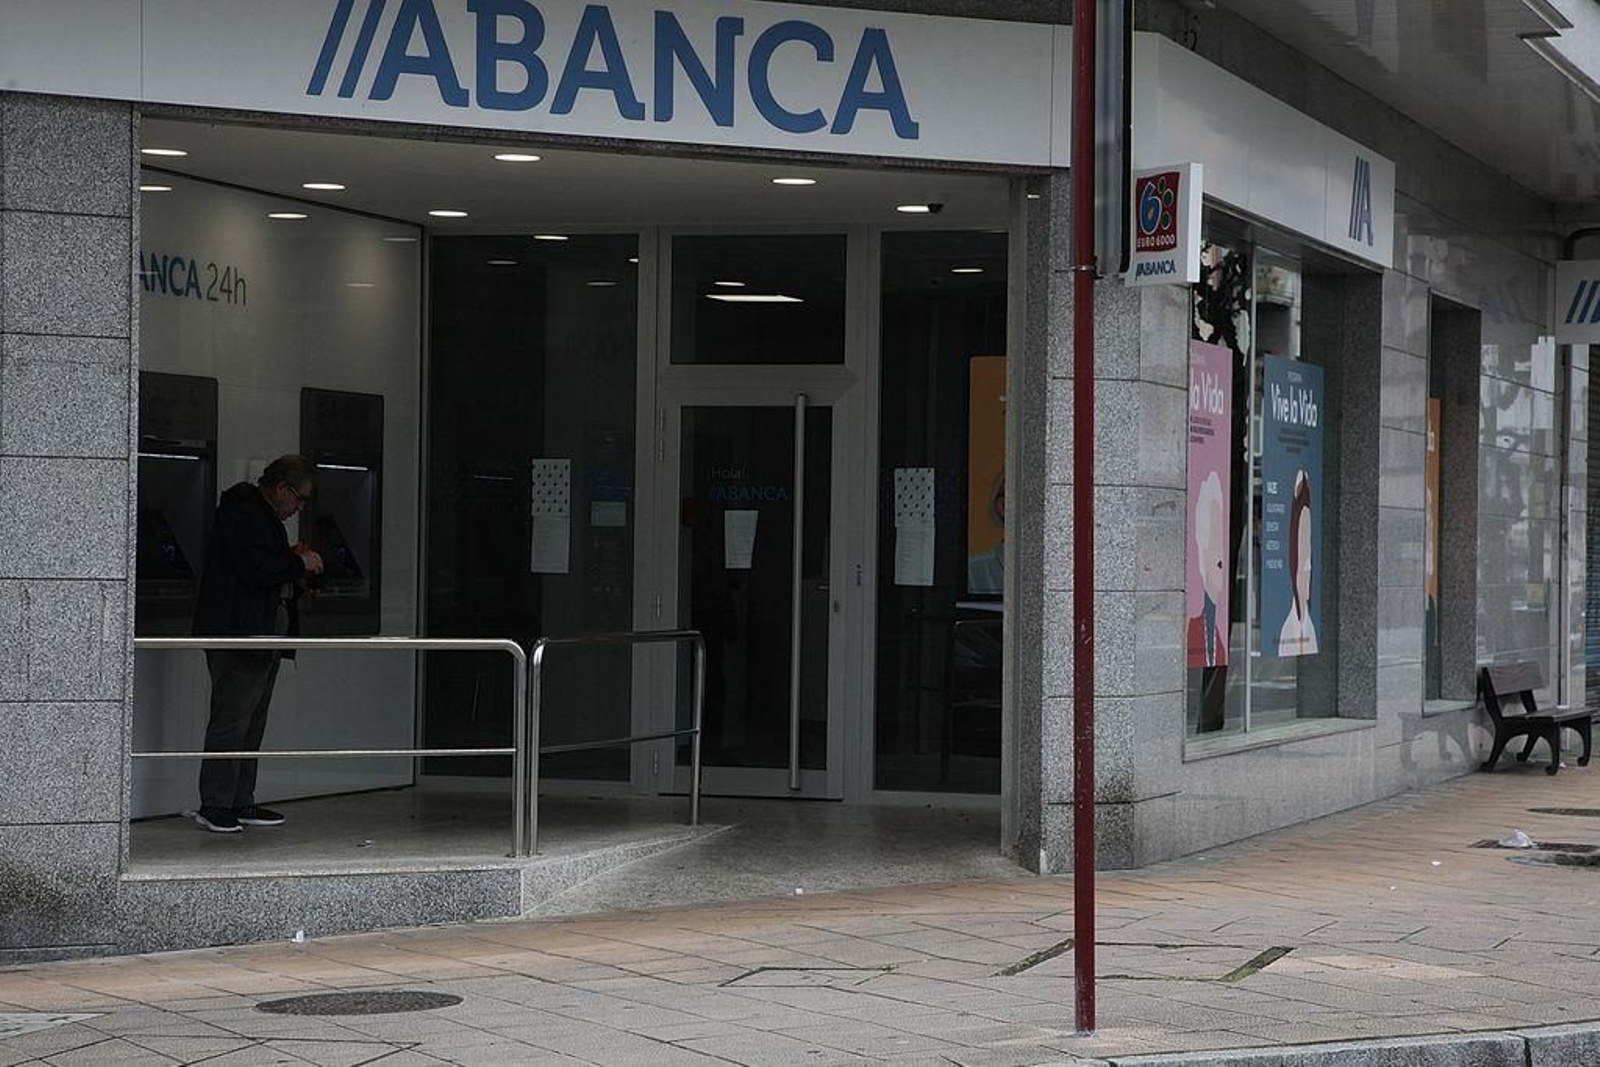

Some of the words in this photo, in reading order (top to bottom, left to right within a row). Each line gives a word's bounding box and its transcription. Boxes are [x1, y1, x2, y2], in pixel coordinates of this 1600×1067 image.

[1137, 236, 1155, 248] EURO
[1156, 234, 1176, 246] 6000
[206, 262, 246, 307] 24h
[1201, 371, 1225, 415] Vida
[1271, 382, 1289, 424] Vive
[1289, 384, 1299, 425] la
[1299, 387, 1318, 429] Vida
